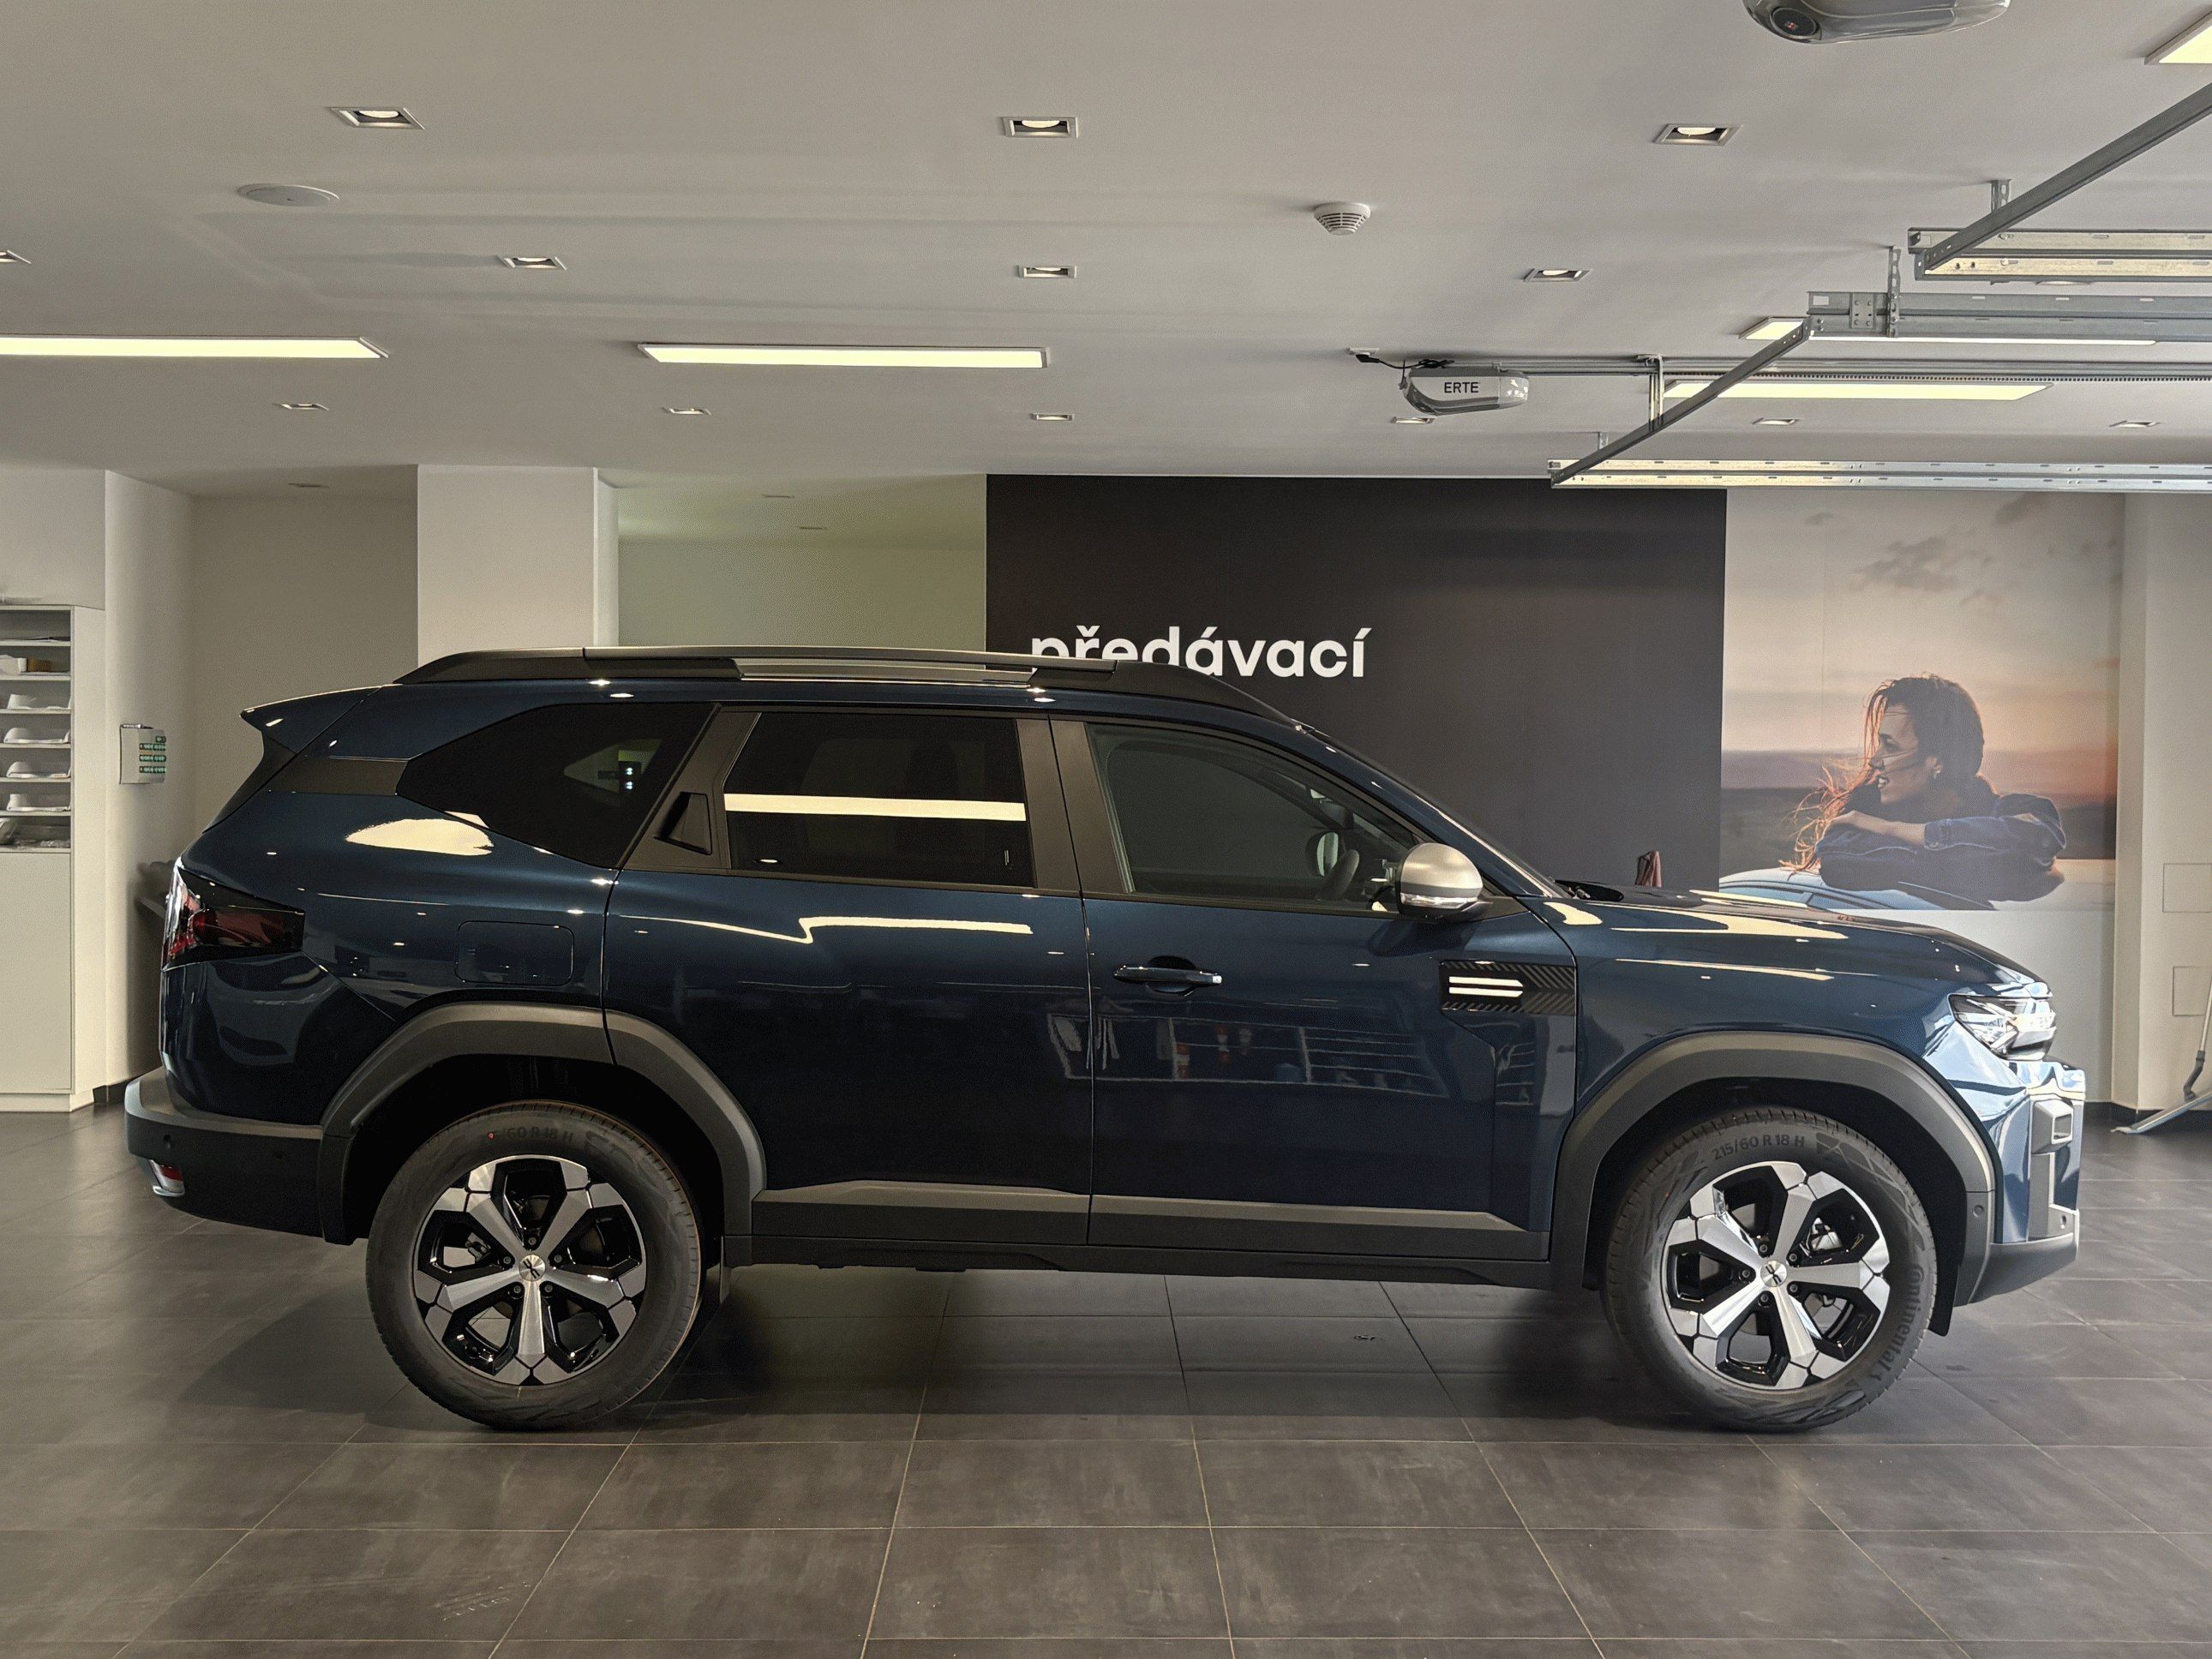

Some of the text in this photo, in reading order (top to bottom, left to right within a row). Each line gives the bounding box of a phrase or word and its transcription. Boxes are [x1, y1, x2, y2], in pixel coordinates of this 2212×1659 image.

[1444, 381, 1479, 393] ERTE
[1712, 1134, 1805, 1160] 215/60 R 18 H
[1877, 1263, 1924, 1372] Continental
